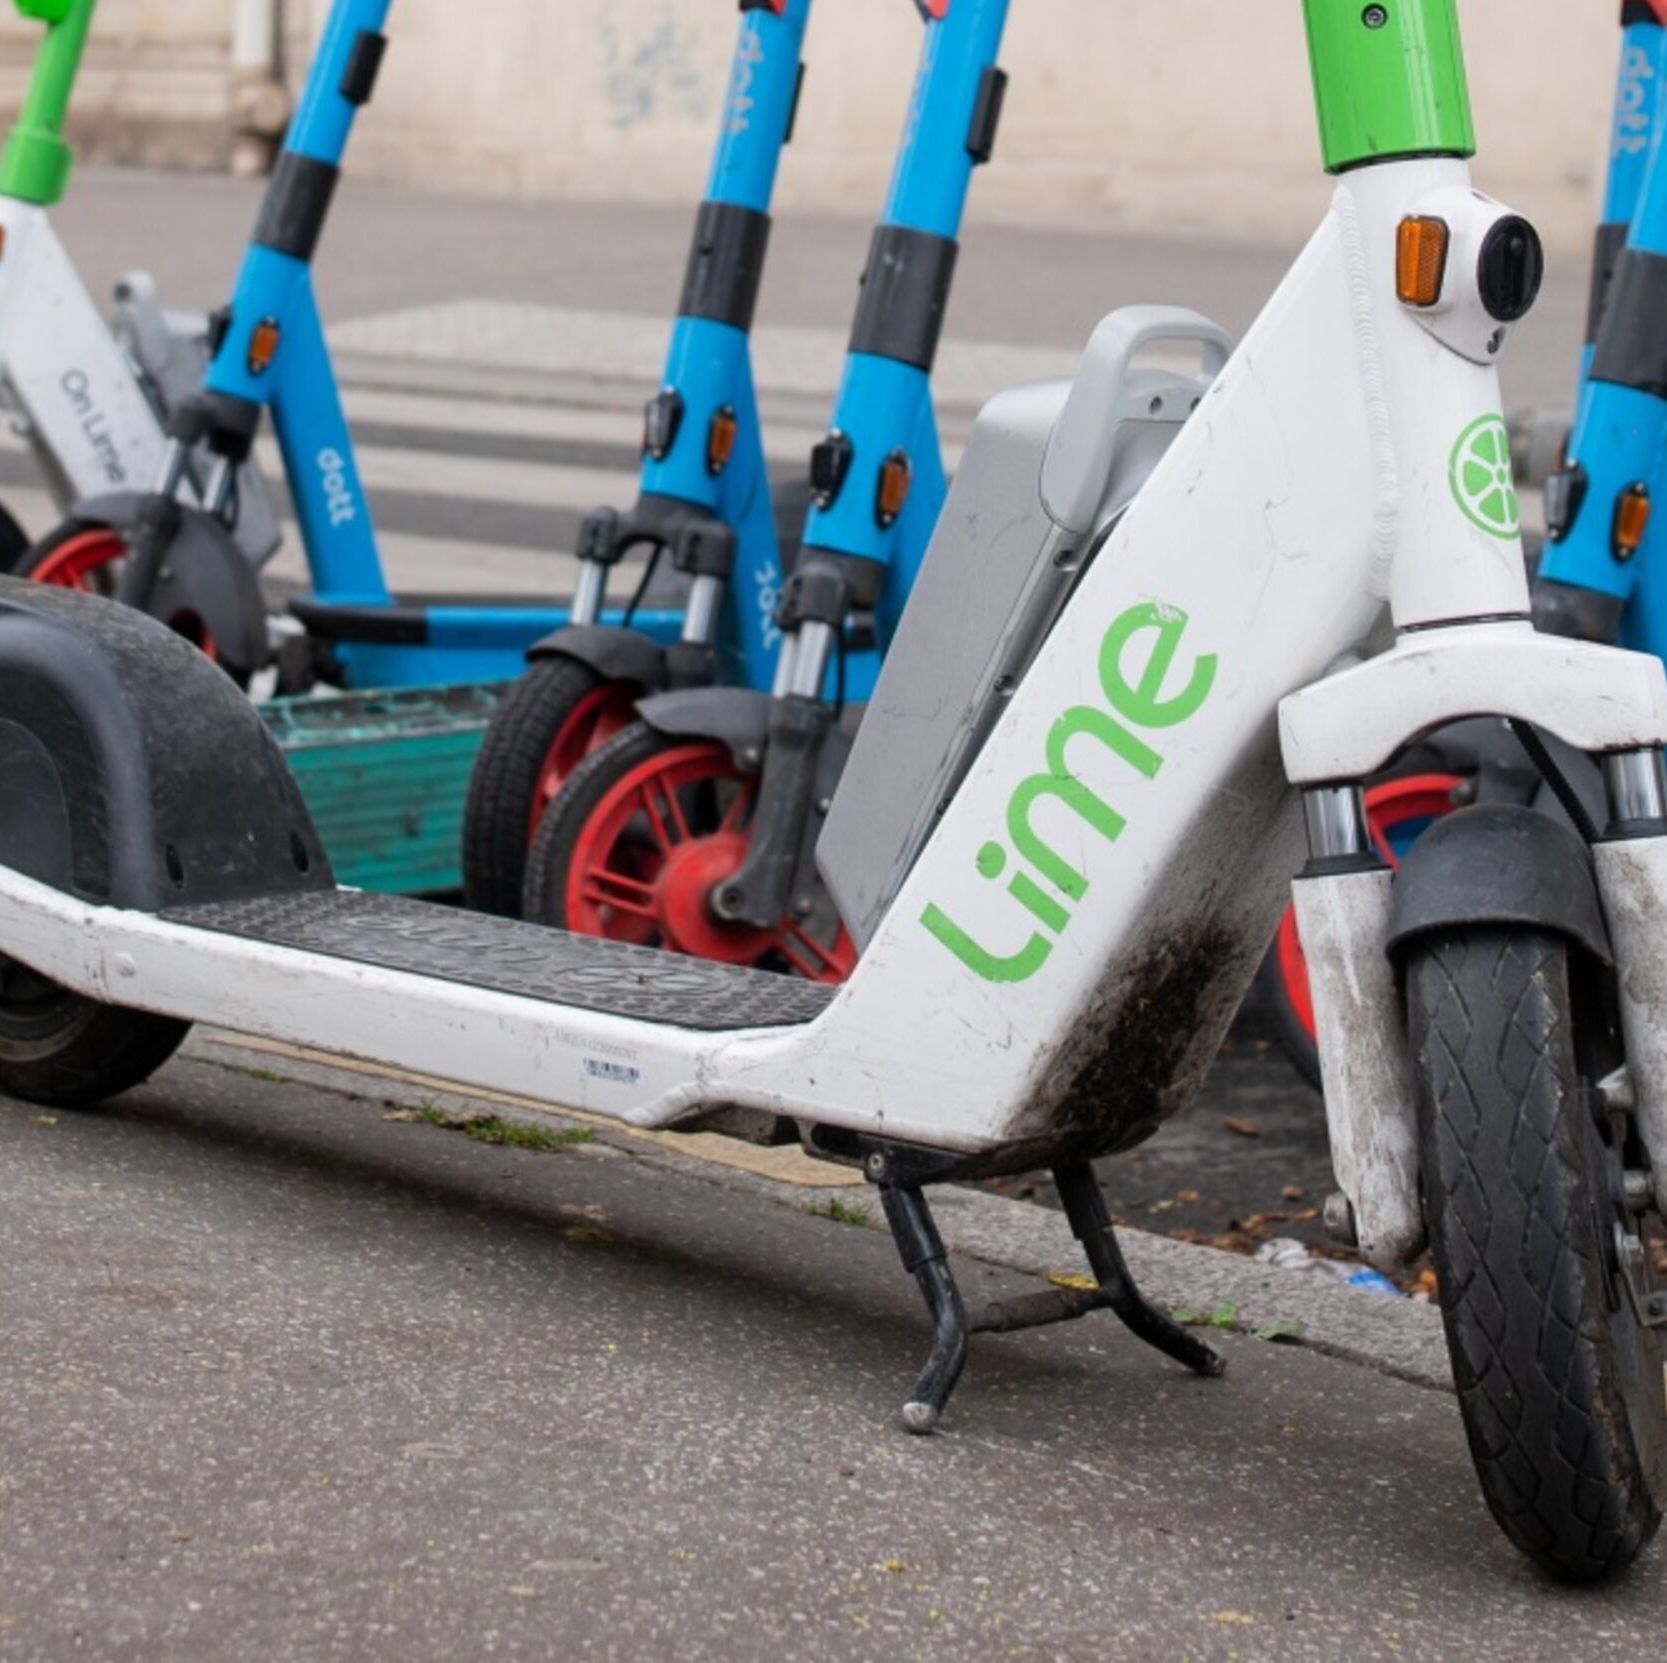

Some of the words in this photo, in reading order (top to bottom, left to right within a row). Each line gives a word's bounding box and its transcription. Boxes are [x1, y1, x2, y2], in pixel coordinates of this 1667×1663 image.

[1612, 44, 1654, 158] dott
[61, 369, 91, 414] On
[84, 413, 126, 484] Lime
[317, 447, 355, 527] dott
[919, 602, 1218, 984] Lime
